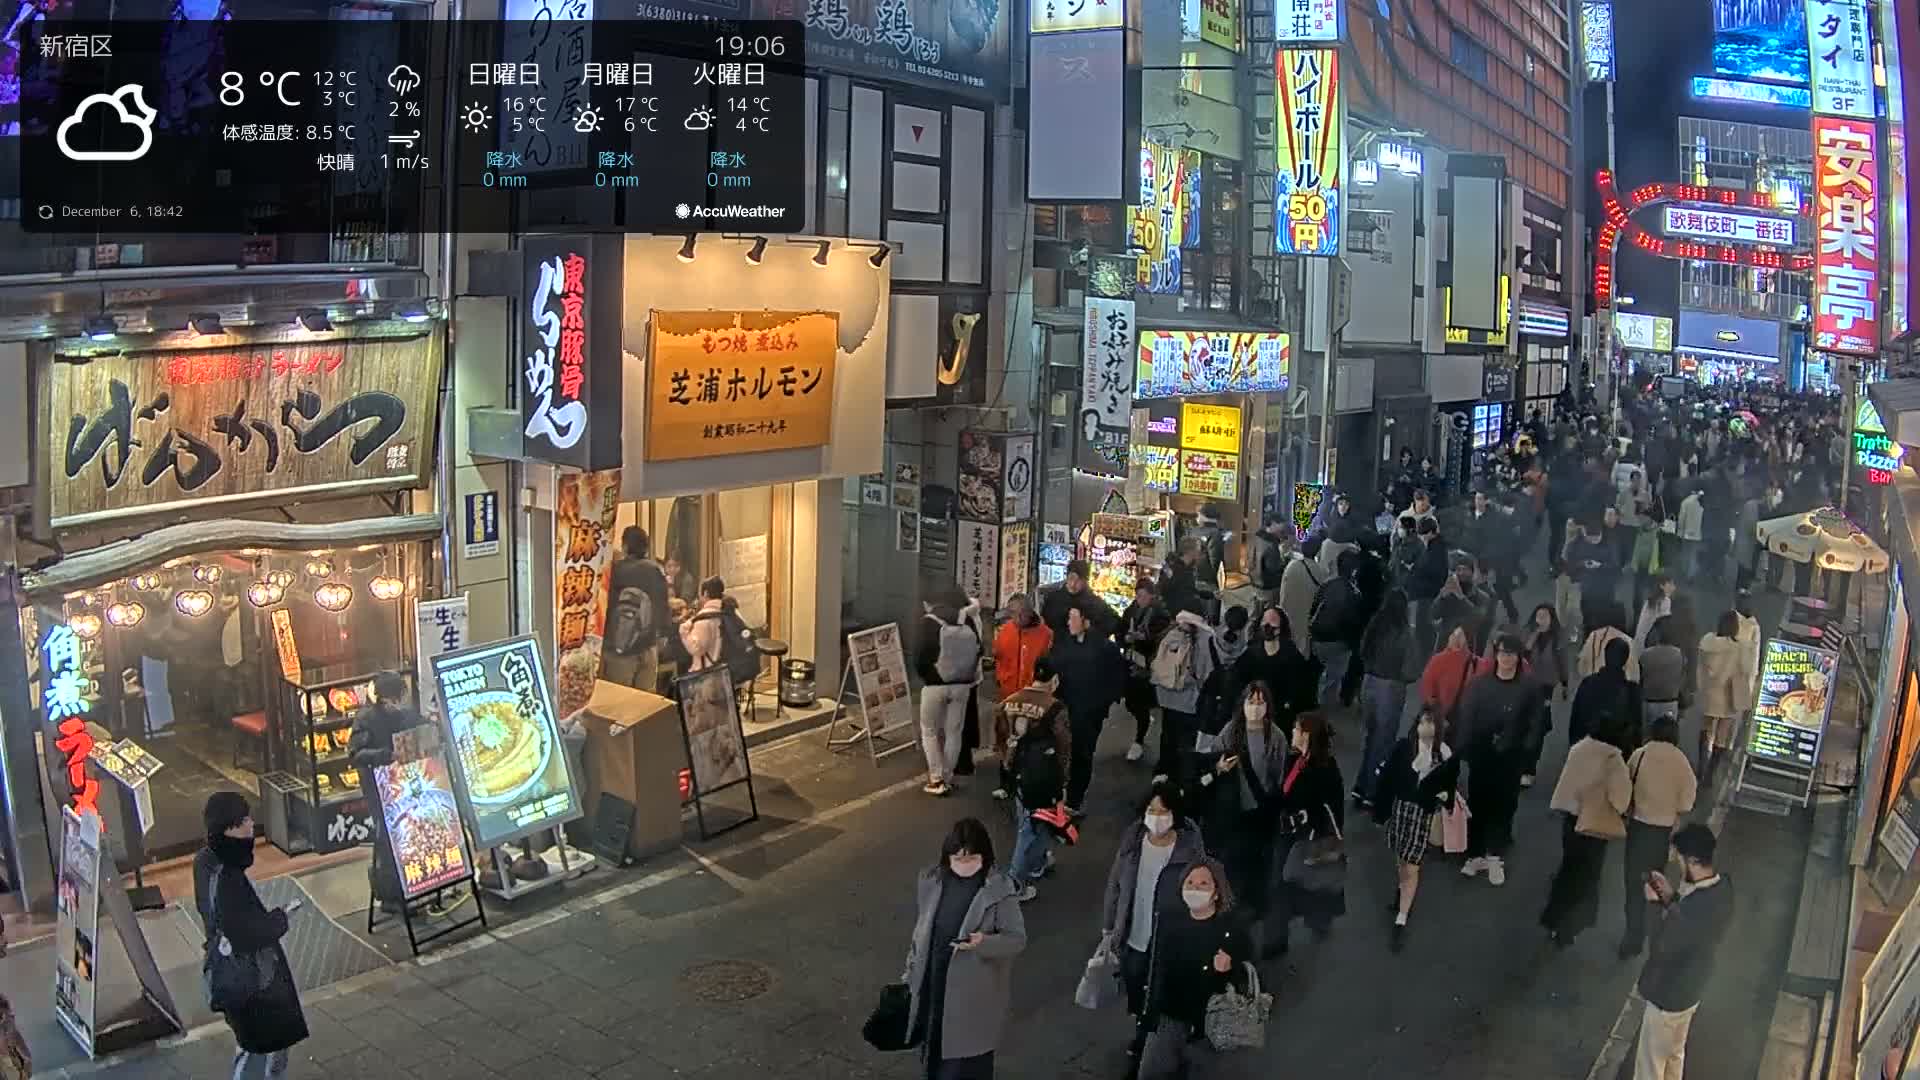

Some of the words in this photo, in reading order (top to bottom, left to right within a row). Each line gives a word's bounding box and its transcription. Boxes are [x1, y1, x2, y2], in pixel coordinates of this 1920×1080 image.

[1832, 96, 1855, 110] 3F
[1296, 54, 1320, 189] ハイボール
[1288, 195, 1327, 221] 50
[1294, 223, 1320, 251] 円
[1670, 210, 1791, 241] 歌舞伎町一番街
[1818, 125, 1876, 330] 安楽亭
[560, 253, 585, 400] 東京豚骨
[1816, 332, 1836, 348] 2F
[702, 332, 747, 354] もつ焼
[1102, 308, 1131, 415] お好み焼き
[668, 366, 823, 406] 芝浦ホルモン
[441, 626, 460, 652] 生
[440, 663, 484, 686] TOKYO
[444, 676, 487, 699] RAMEN
